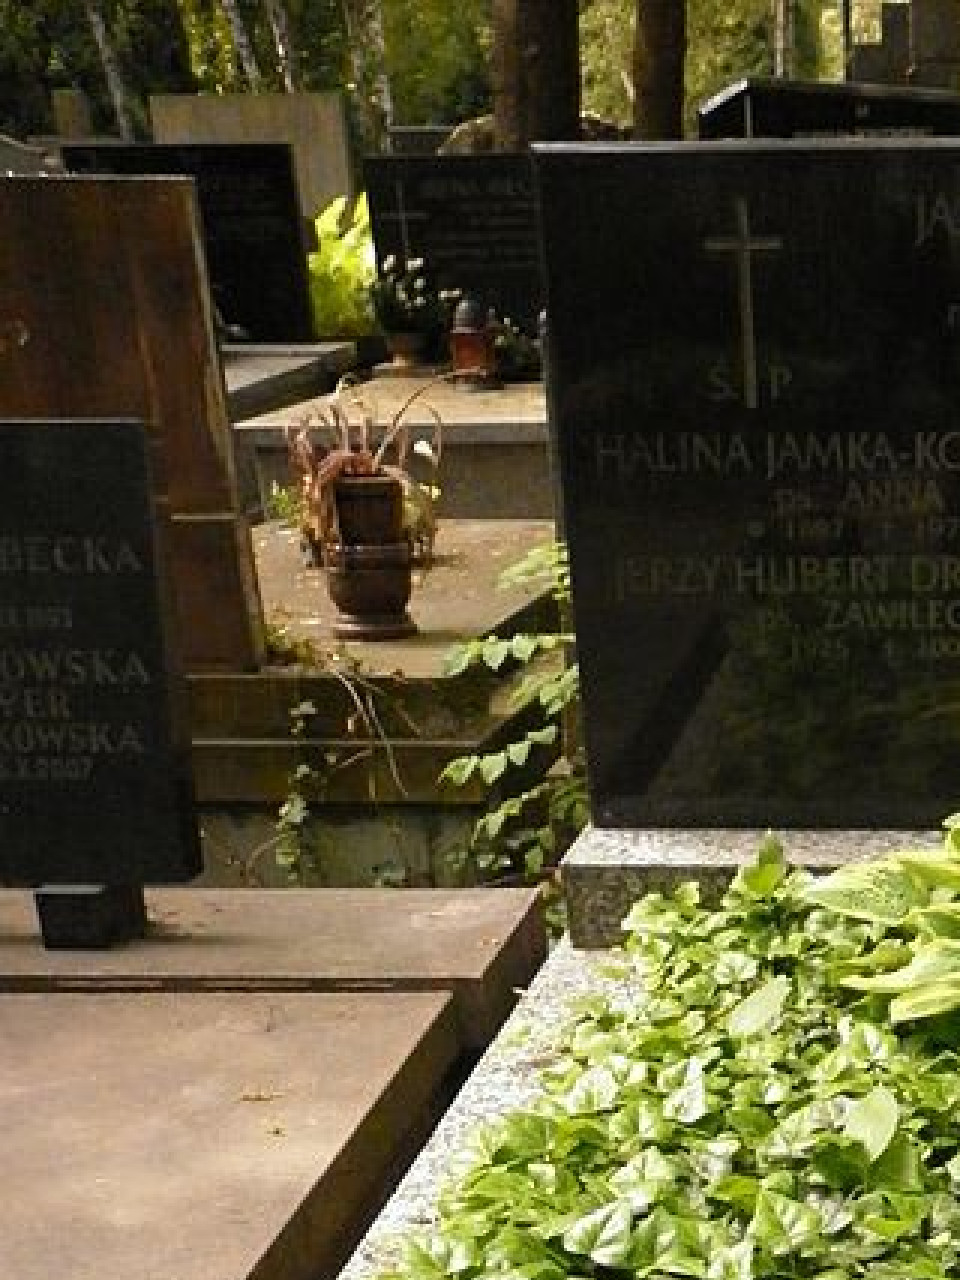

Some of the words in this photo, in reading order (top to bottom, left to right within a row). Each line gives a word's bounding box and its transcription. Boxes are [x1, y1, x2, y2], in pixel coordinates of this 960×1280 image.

[594, 431, 755, 475] HALINA
[841, 479, 948, 511] ANNA
[613, 556, 722, 602] JERZY
[733, 554, 896, 594] HUBERT
